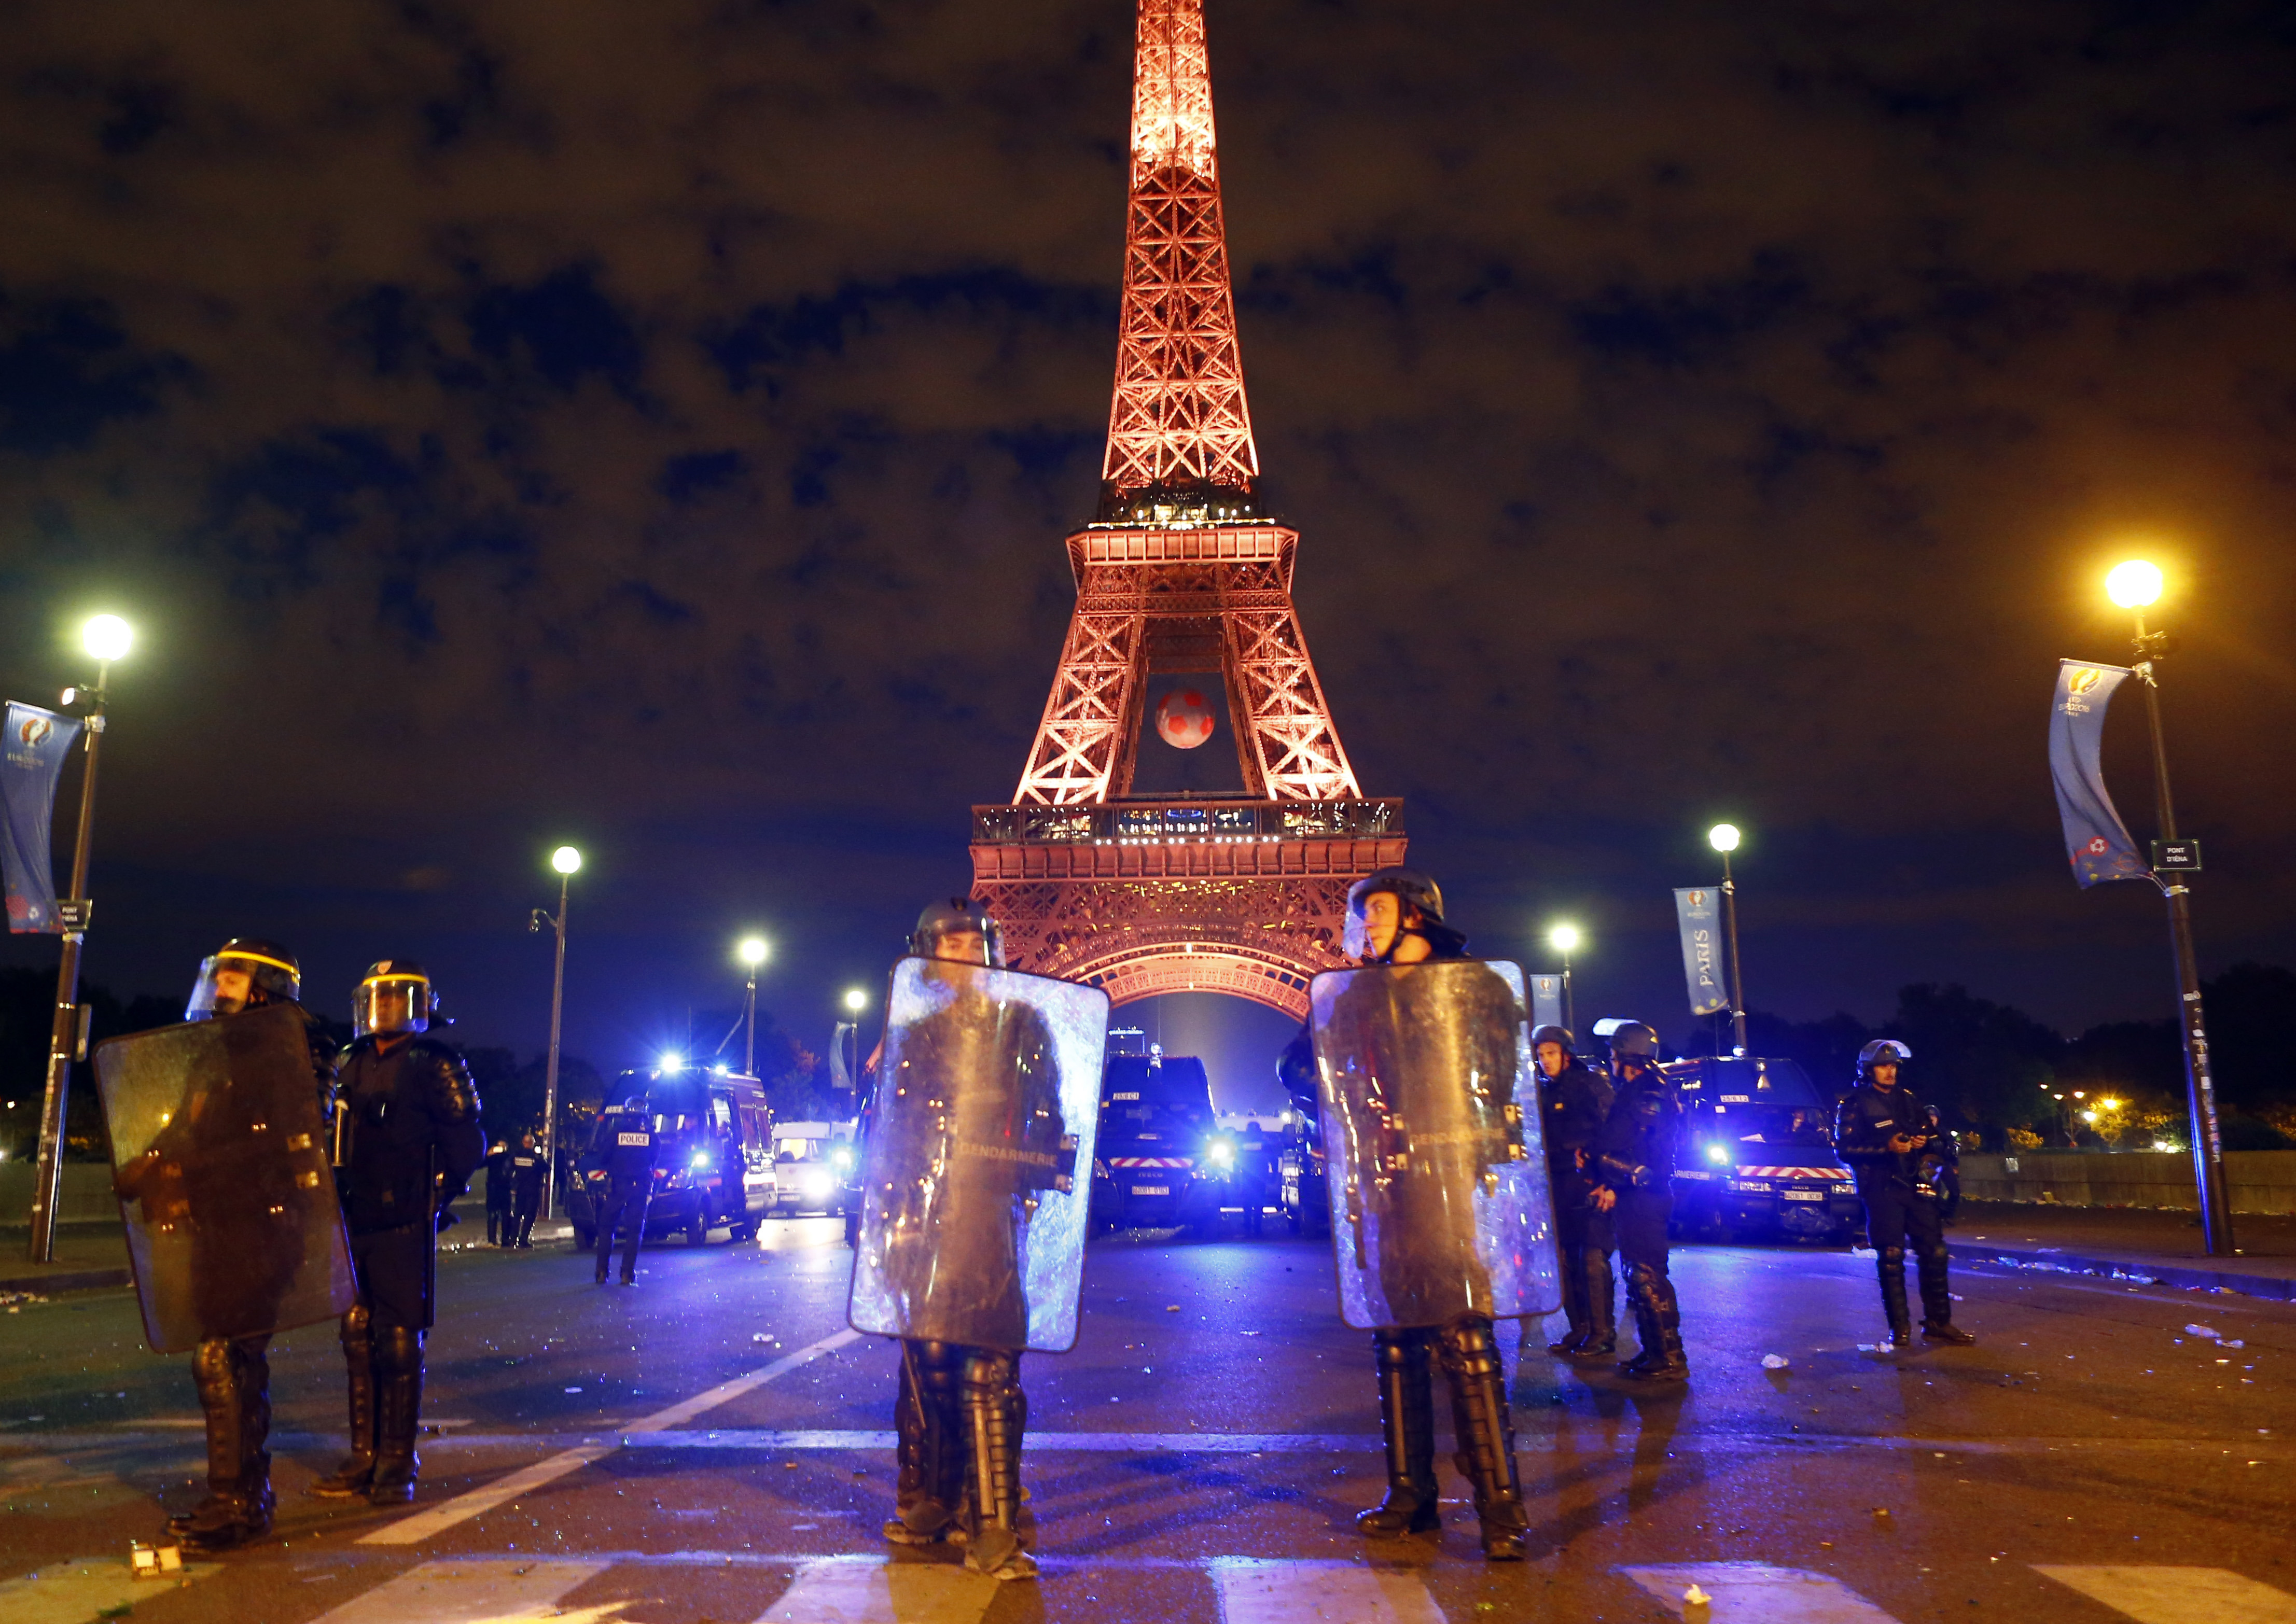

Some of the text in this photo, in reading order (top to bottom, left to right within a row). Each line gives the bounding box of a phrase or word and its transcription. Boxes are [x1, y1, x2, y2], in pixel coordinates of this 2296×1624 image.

[1694, 929, 1714, 986] PARIS
[620, 1135, 647, 1144] POLICE
[959, 1142, 1058, 1167] GENDARMERIE
